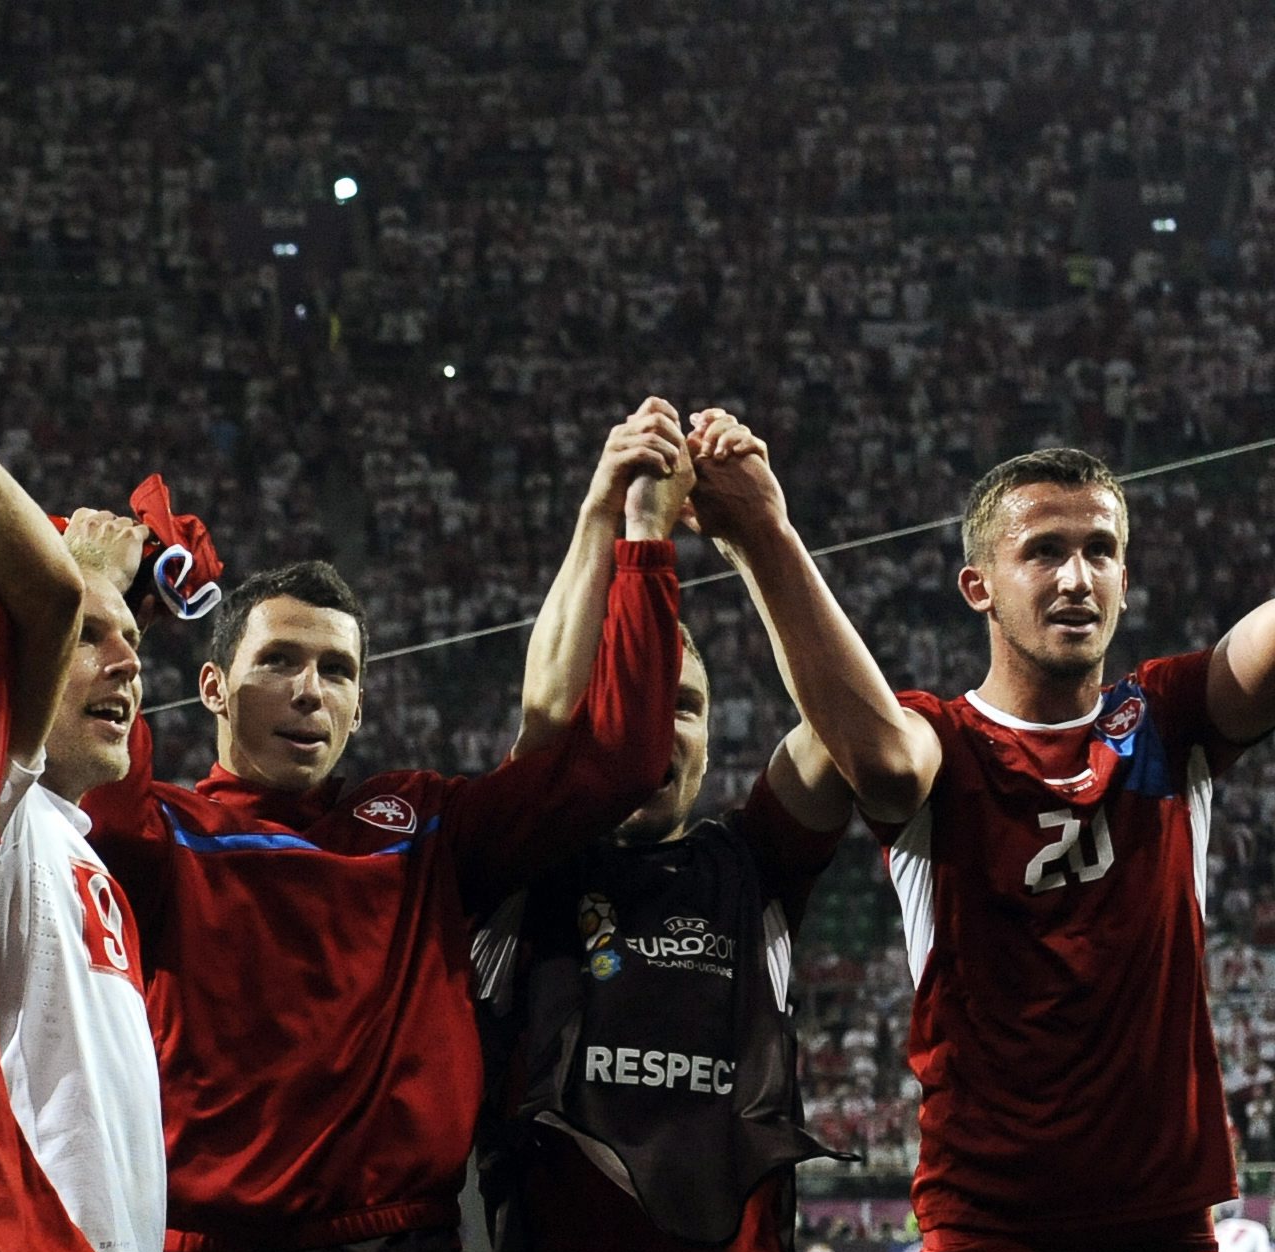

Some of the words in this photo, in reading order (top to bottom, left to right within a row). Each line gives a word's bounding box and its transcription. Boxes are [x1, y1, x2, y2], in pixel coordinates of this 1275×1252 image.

[1024, 806, 1115, 893] 20
[87, 872, 129, 971] 9
[585, 1046, 736, 1094] RESPEC
